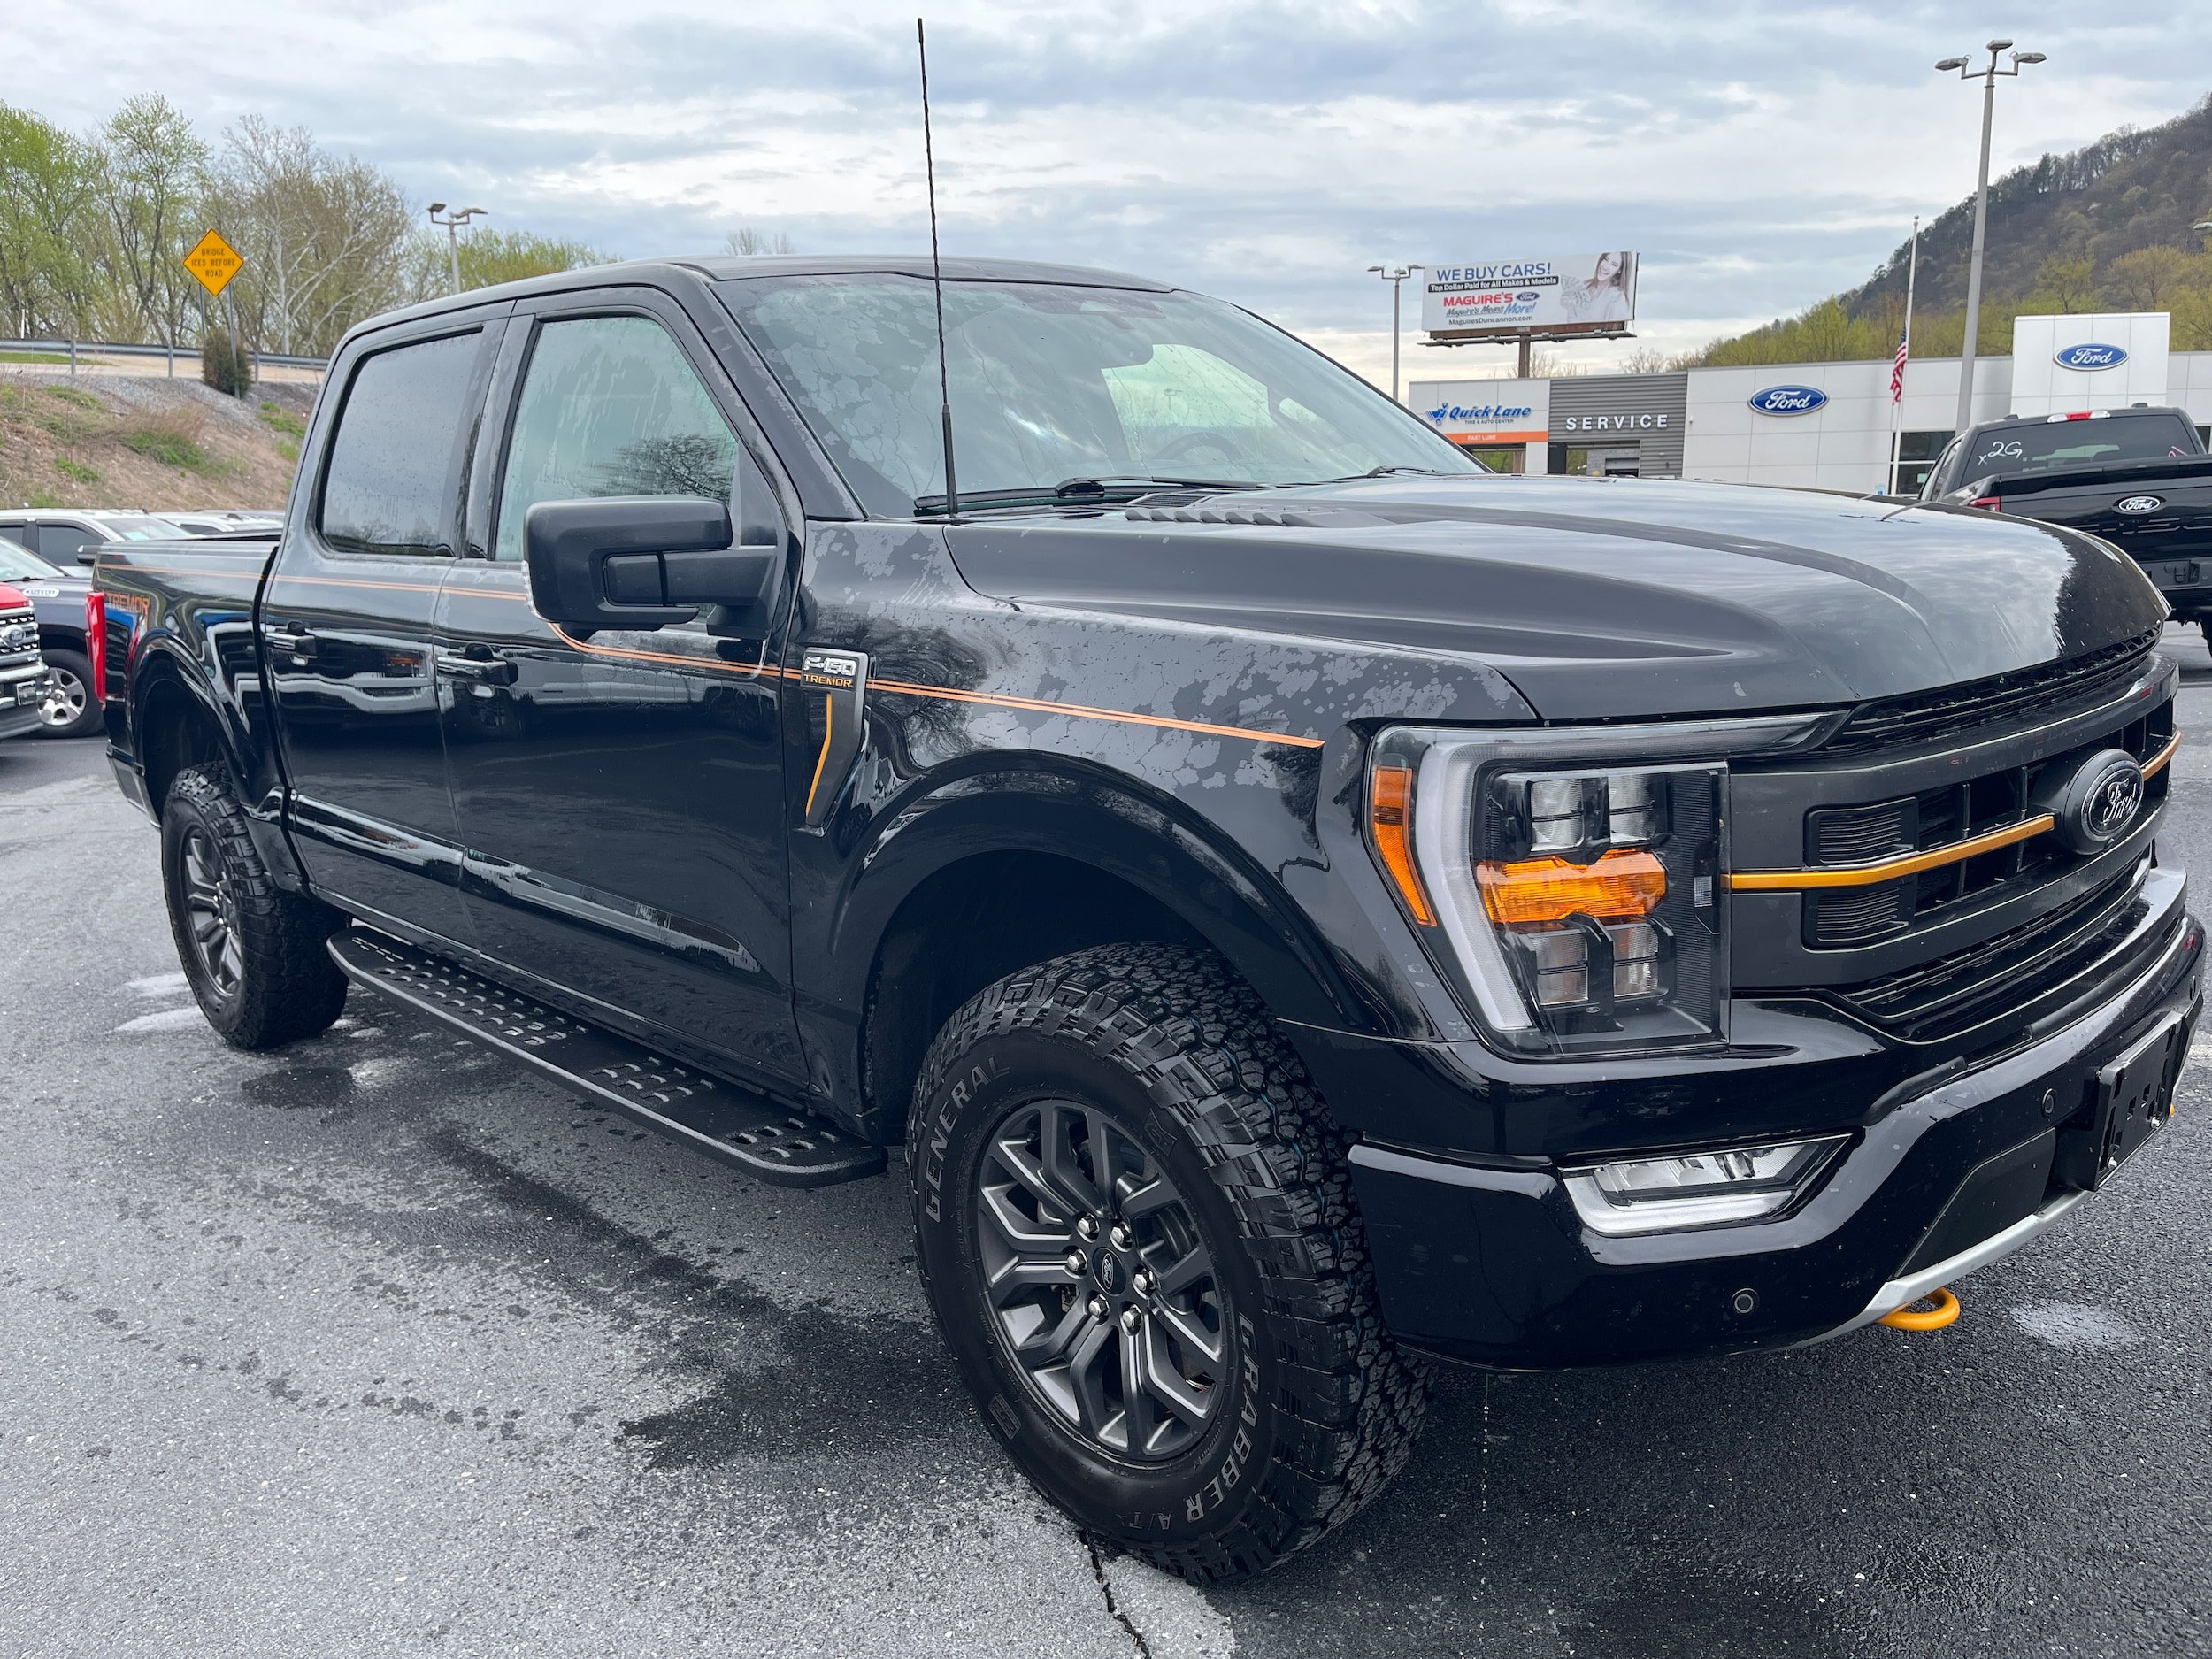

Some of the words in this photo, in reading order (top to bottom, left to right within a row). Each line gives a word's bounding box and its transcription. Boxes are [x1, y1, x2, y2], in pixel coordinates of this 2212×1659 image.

[191, 258, 206, 267] ICES
[211, 258, 235, 267] BEFORE
[1437, 269, 1461, 282] WE
[1464, 266, 1498, 280] BUY
[1502, 262, 1551, 277] CARS!
[1443, 292, 1513, 307] MAGUIRE'S
[1519, 292, 1537, 301] Ford
[1504, 302, 1537, 314] More!
[1449, 316, 1533, 326] MaguiresDuncannon.com
[2070, 348, 2113, 364] Ford
[1765, 391, 1811, 409] Ford
[1449, 406, 1493, 419] Quick
[1494, 405, 1532, 418] Lane
[1565, 414, 1668, 430] SERVICE
[2125, 498, 2154, 511] Ford
[106, 592, 150, 615] TREMOR
[803, 656, 857, 676] F-150
[803, 673, 854, 687] TREMOR
[2100, 778, 2137, 826] Ford
[925, 1056, 1010, 1223] GENERAL
[1185, 1311, 1260, 1524] GRABBER
